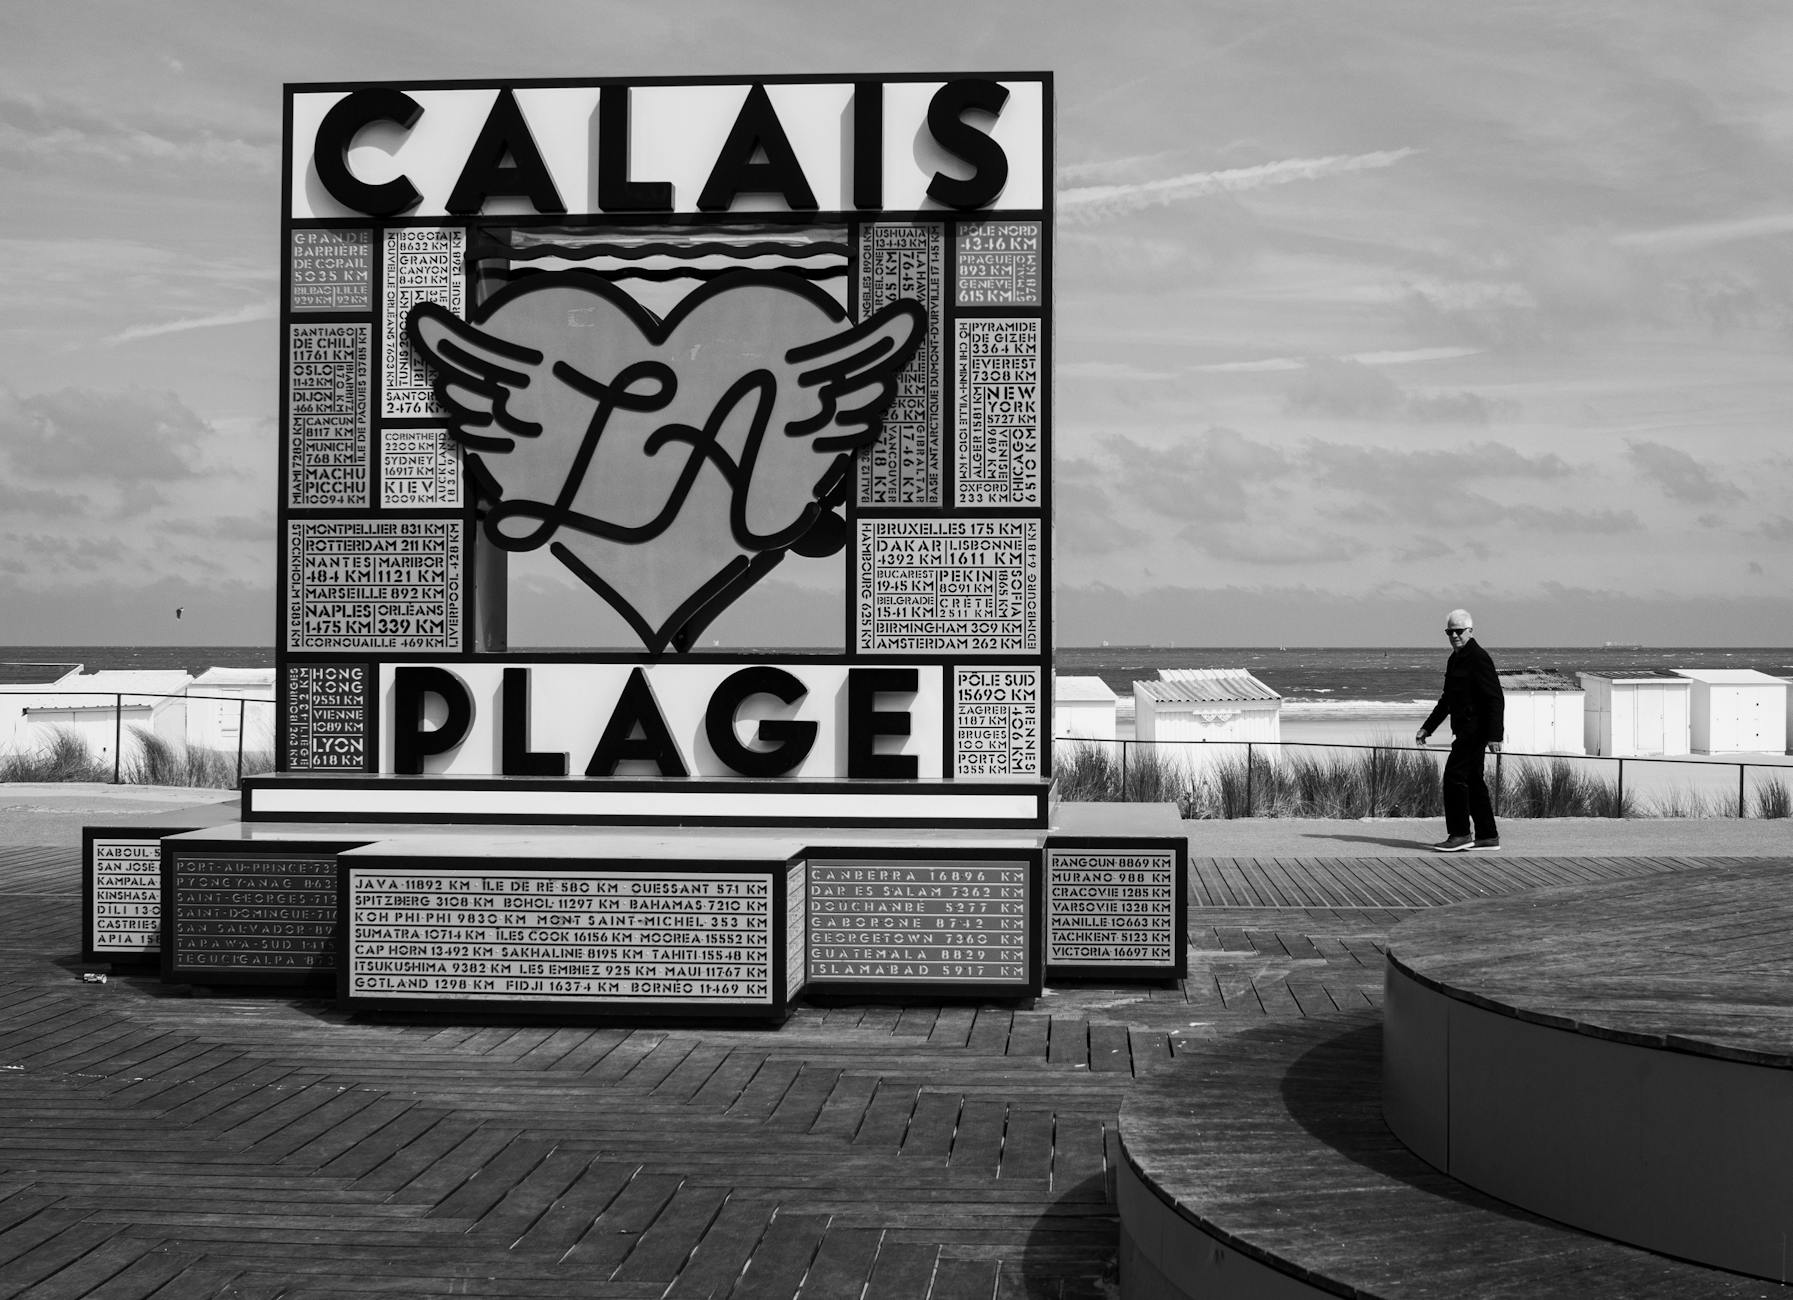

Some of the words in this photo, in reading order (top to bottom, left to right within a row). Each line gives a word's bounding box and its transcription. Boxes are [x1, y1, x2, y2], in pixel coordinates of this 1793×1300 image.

[313, 79, 1010, 215] CALAIS
[400, 231, 448, 241] BOGOTA
[875, 229, 927, 238] USHUAIA
[998, 225, 1037, 236] NORD
[295, 232, 368, 244] GRANDE
[961, 237, 1006, 250] 4346
[1010, 237, 1037, 250] KM
[400, 242, 429, 252] 8632
[432, 242, 448, 251] KM
[294, 259, 312, 269] DE
[315, 258, 368, 268] CORAIL
[400, 255, 448, 265] GRAND
[959, 255, 1012, 264] PRAGUE
[295, 270, 337, 282] 5035
[344, 270, 368, 280] KM
[400, 266, 448, 275] CANYON
[960, 265, 986, 276] 893
[991, 265, 1012, 276] KM
[293, 327, 355, 337] SANTIAGO
[972, 322, 1036, 332] PYRAMIDE
[293, 338, 314, 349] DE
[318, 337, 355, 349] CHILI
[972, 334, 989, 343] DE
[995, 333, 1036, 343] GIZEH
[972, 344, 1009, 354] 3364
[1014, 344, 1036, 354] KM
[293, 350, 329, 361] 11761
[333, 349, 354, 361] KM
[972, 359, 1036, 369] EVEREST
[293, 365, 333, 376] OSLO
[972, 371, 1011, 381] 7308
[1015, 371, 1036, 381] KM
[293, 391, 333, 402] DIJON
[987, 386, 1036, 400] NEW
[987, 402, 1036, 413] YORK
[306, 417, 354, 426] CANCUN
[987, 414, 1015, 424] 5727
[1018, 414, 1036, 424] KM
[306, 427, 330, 437] 8117
[335, 427, 354, 437] KM
[930, 390, 939, 470] ANTARCTIQUE
[385, 432, 435, 441] CORINTHE
[305, 442, 353, 452] MUNICH
[306, 454, 329, 464] 768
[333, 454, 353, 464] KM
[385, 457, 433, 465] SYDNEY
[385, 466, 413, 475] 16917
[416, 466, 434, 475] KM
[1012, 428, 1023, 503] CHICAGO
[305, 468, 366, 480] MACHU
[305, 482, 366, 494] PICCHU
[385, 481, 433, 493] KIEV
[930, 473, 939, 503] BASE
[960, 483, 1008, 492] OXFORD
[305, 523, 397, 535] MONTPELLIER
[400, 524, 421, 535] 831
[425, 523, 445, 534] KM
[449, 523, 459, 540] KM
[877, 523, 966, 535] BRUXELLES
[971, 523, 994, 534] 175
[999, 523, 1022, 535] KM
[305, 539, 397, 552] ROTTERDAM
[401, 540, 418, 551] 211
[423, 540, 444, 551] KM
[877, 540, 942, 551] DAKAR
[950, 540, 1022, 550] LISBONNE
[305, 557, 371, 568] NANTES
[379, 557, 444, 568] MARIBOR
[950, 553, 985, 565] 1611
[995, 553, 1022, 565] KM
[378, 570, 411, 583] 1121
[418, 570, 444, 582] KM
[939, 570, 993, 582] PEKIN
[305, 588, 387, 599] MARSEILLE
[391, 588, 418, 599] 892
[422, 588, 444, 598] KM
[1011, 570, 1022, 617] SOFIA
[305, 605, 371, 618] NAPLES
[449, 574, 459, 647] LIVERPOOL
[378, 619, 411, 634] 339
[416, 620, 444, 633] KM
[876, 623, 967, 633] BIRMINGHAM
[971, 623, 998, 633] 309
[1001, 623, 1022, 633] KM
[877, 638, 968, 648] AMSTERDAM
[972, 638, 997, 649] 262
[1001, 638, 1022, 648] KM
[313, 668, 363, 680] HONG
[1005, 675, 1035, 686] SUD
[313, 681, 363, 693] KONG
[313, 696, 341, 705] 9551
[344, 695, 363, 704] KM
[958, 689, 1006, 701] 15690
[1011, 689, 1035, 701] KM
[313, 710, 363, 720] VIENNE
[958, 706, 1007, 714] ZAGREB
[394, 664, 918, 777] PLAGE
[958, 730, 1007, 739] BRUGES
[1025, 706, 1035, 771] RENNES
[313, 738, 363, 752] LYON
[313, 754, 337, 765] 618
[342, 755, 363, 765] KM
[958, 754, 1007, 764] PORTO
[97, 848, 149, 857] KABOUL
[1052, 858, 1114, 867] RANGOUN
[1119, 858, 1149, 868] 8869
[1153, 859, 1171, 868] KM
[811, 870, 915, 880] CANBERRA
[929, 871, 985, 881] 16896
[1001, 872, 1024, 881] KM
[97, 877, 155, 886] KAMPALA
[97, 891, 156, 900] KINSHASA
[1052, 888, 1118, 897] CRACOVIE
[1122, 888, 1148, 897] 1285
[1152, 888, 1170, 897] KM
[97, 920, 157, 929] CASTRIES
[355, 929, 419, 939] SUMATRA
[425, 929, 461, 939] 10714
[465, 930, 485, 940] KM
[528, 931, 569, 942] COOK
[574, 932, 607, 942] 16156
[612, 933, 632, 942] KM
[640, 933, 700, 943] MOOREA
[706, 933, 742, 944] 15552
[747, 934, 767, 944] KM
[355, 945, 384, 955] CAP
[389, 945, 427, 956] HORN
[431, 946, 469, 956] 13492
[473, 947, 493, 956] KM
[502, 947, 582, 959] SAKHALINE
[587, 948, 617, 959] 8195
[622, 949, 643, 959] KM
[652, 950, 697, 960] TAHITI
[702, 950, 741, 961] 15548
[747, 951, 767, 961] KM
[1052, 947, 1110, 956] VICTORIA
[1115, 948, 1148, 957] 16697
[1152, 948, 1170, 957] KM
[811, 964, 928, 975] ISLAMABAD
[943, 966, 984, 975] 5917
[1001, 966, 1023, 976] KM
